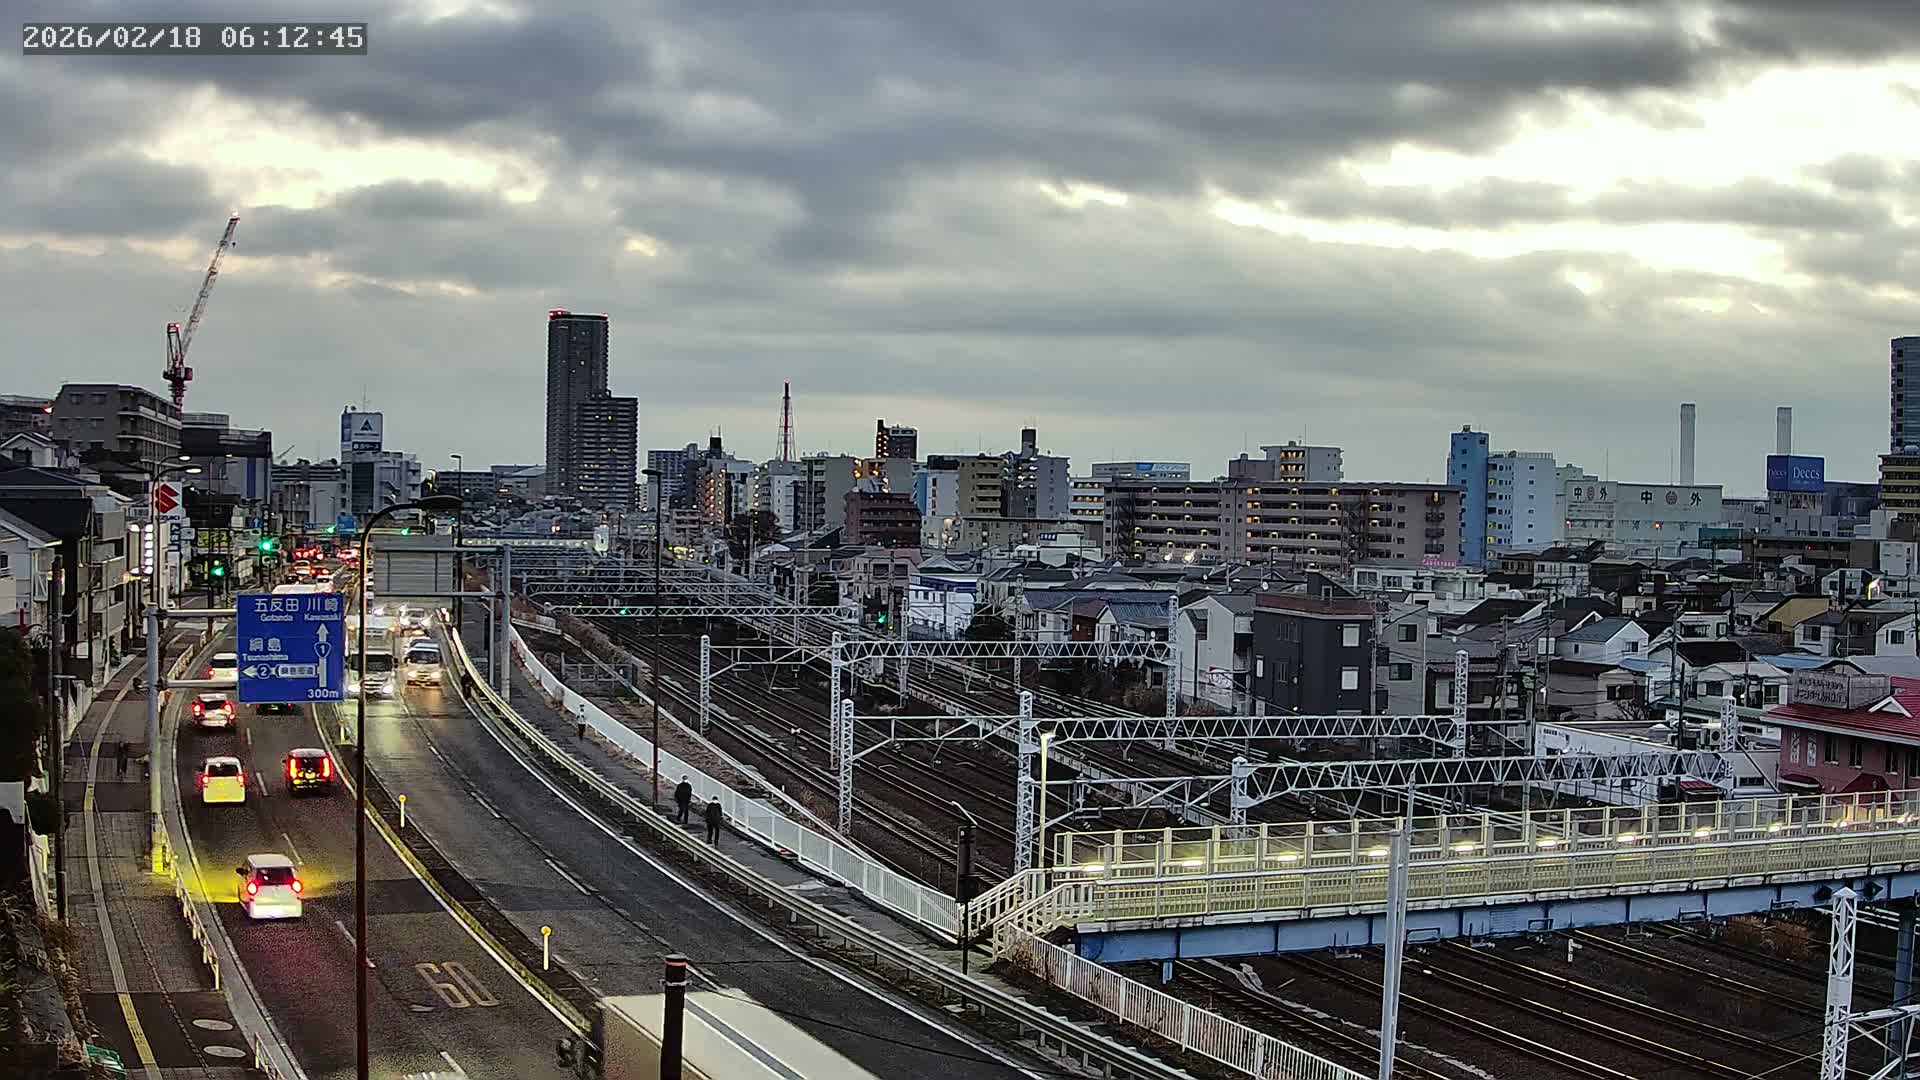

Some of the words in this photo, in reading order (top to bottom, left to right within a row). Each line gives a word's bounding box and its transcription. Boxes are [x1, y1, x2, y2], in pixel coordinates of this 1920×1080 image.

[1640, 490, 1653, 504] 中
[1690, 491, 1702, 507] 外
[254, 598, 299, 612] 五反田
[306, 597, 339, 611] 川崎
[307, 688, 339, 699] 300m
[415, 961, 500, 1008] 60
